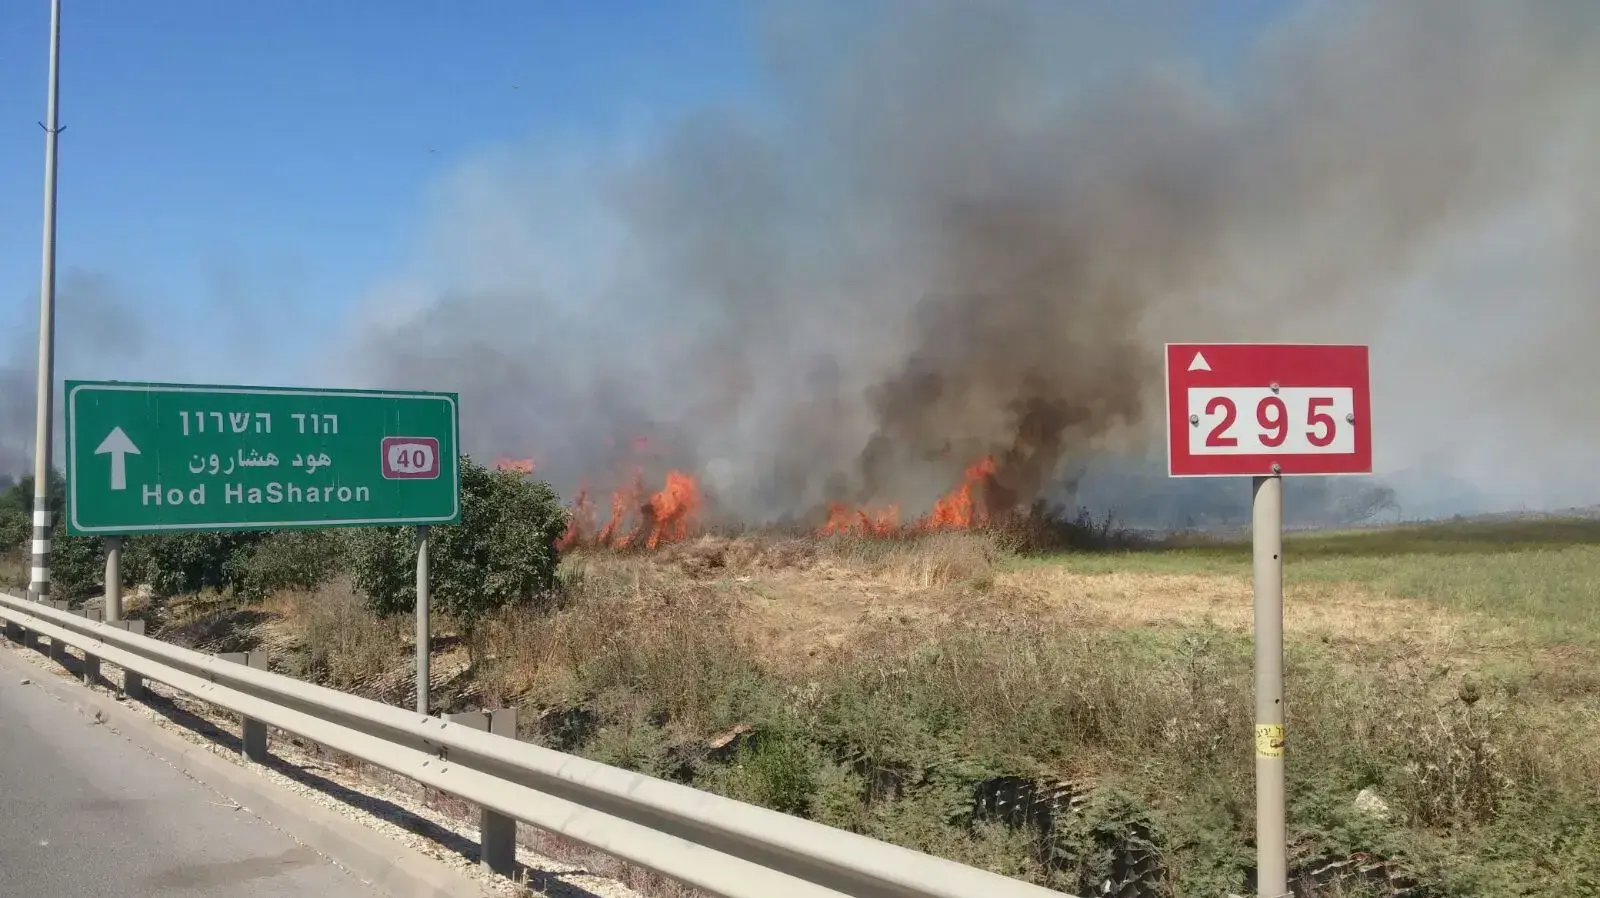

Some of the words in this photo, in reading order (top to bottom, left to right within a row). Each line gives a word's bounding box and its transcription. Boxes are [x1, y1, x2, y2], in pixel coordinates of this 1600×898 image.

[179, 410, 272, 436] השרון
[290, 412, 338, 434] הוד
[1204, 396, 1337, 448] 295
[188, 449, 280, 474] هشارون
[291, 454, 332, 474] هود
[396, 449, 427, 469] 40
[142, 484, 206, 506] Hod
[224, 482, 370, 504] HaSharon
